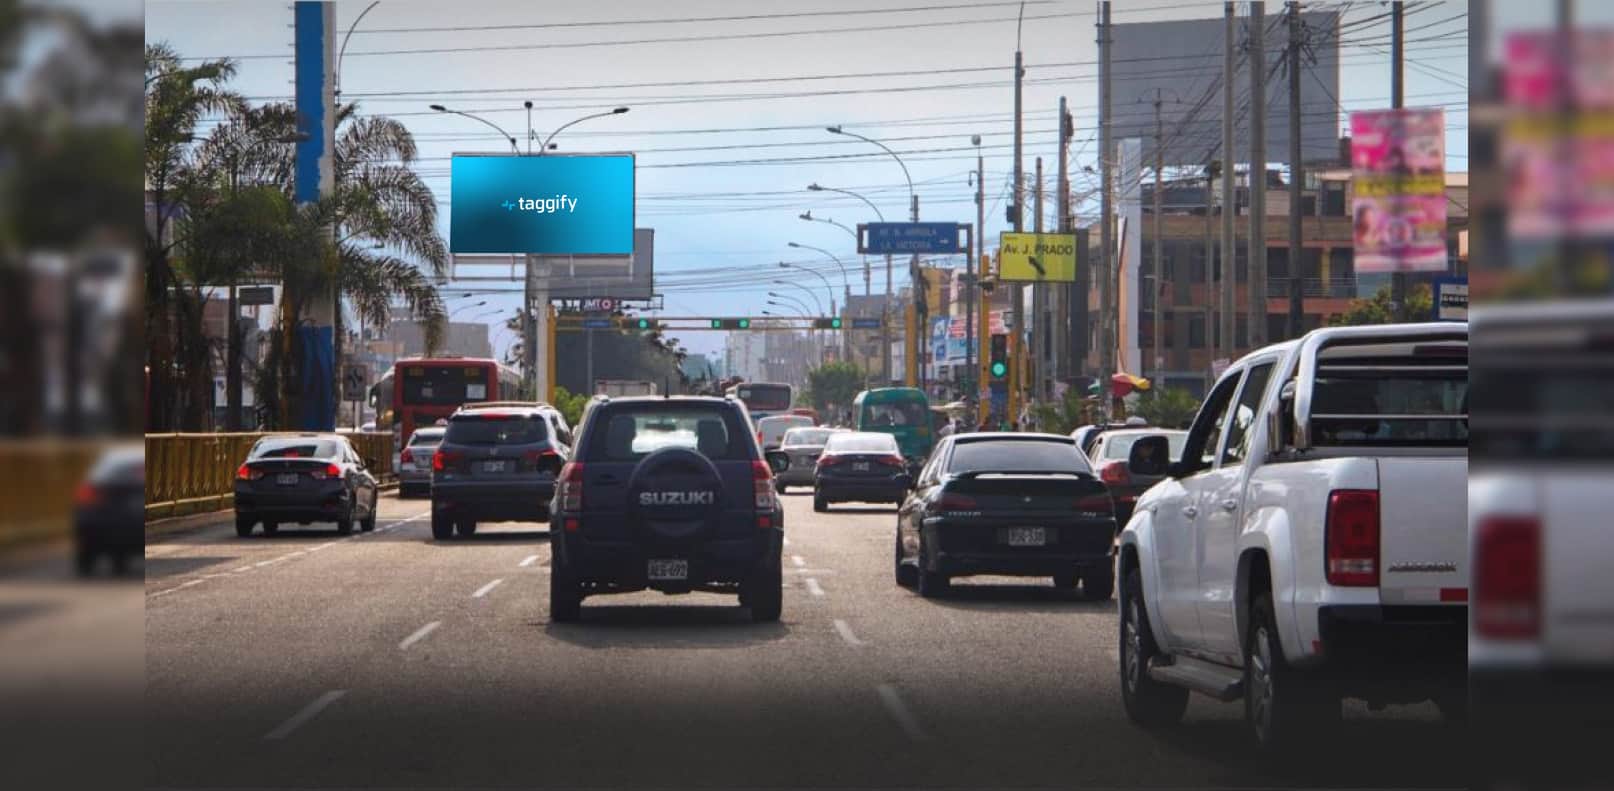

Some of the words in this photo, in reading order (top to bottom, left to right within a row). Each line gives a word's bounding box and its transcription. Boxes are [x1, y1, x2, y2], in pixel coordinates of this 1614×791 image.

[518, 194, 577, 213] taggify
[1004, 243, 1019, 254] Av.
[1035, 243, 1073, 255] PRADO
[639, 491, 714, 505] SUZUKI
